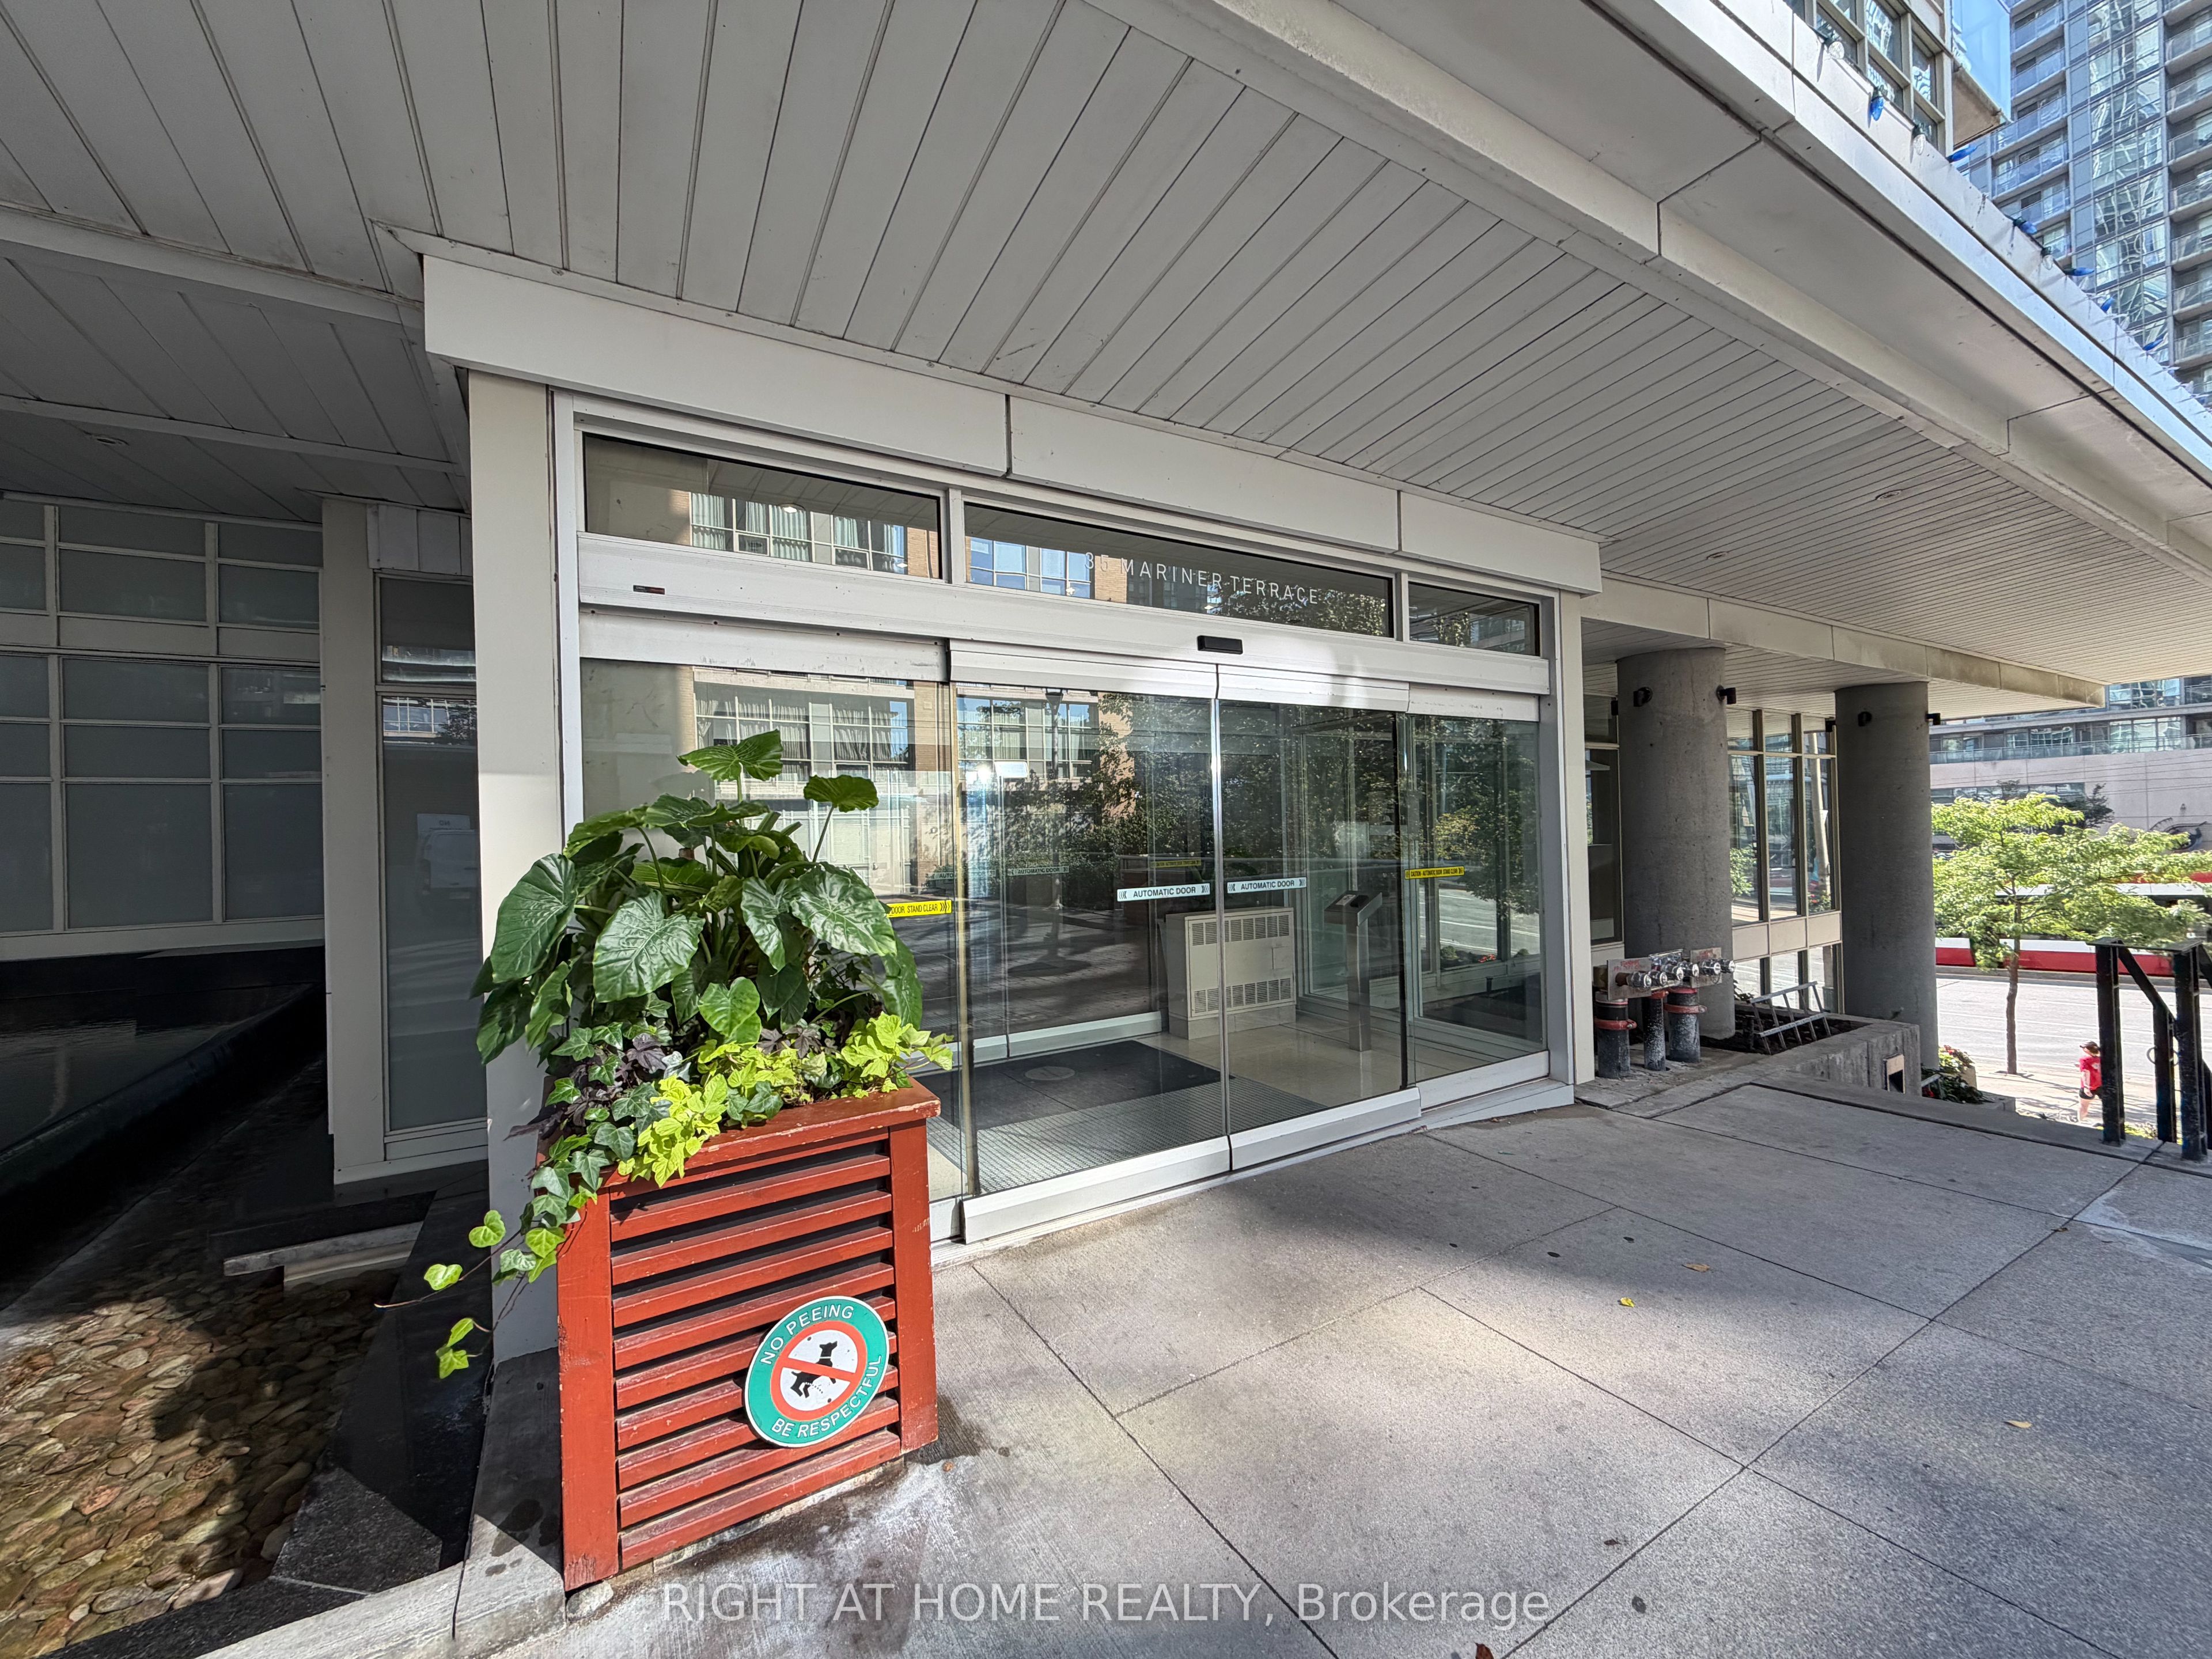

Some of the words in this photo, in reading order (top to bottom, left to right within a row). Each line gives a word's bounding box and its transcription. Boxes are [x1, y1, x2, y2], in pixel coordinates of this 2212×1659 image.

[1085, 551, 1109, 573] 35
[1120, 558, 1222, 590] MARINER
[1230, 575, 1319, 604] TERRACE
[1133, 888, 1174, 898] AUTOMATIC
[1176, 886, 1196, 895] DOOR
[1241, 881, 1276, 890] AUTOMATIC
[1277, 880, 1295, 888] DOOR
[892, 906, 905, 914] DOOR
[907, 905, 922, 914] STAND
[923, 904, 938, 912] CLEAR
[760, 1336, 784, 1365] NO
[786, 1304, 854, 1335] PEEING
[771, 1418, 794, 1437] BE
[797, 1355, 881, 1438] RESPECTFUL
